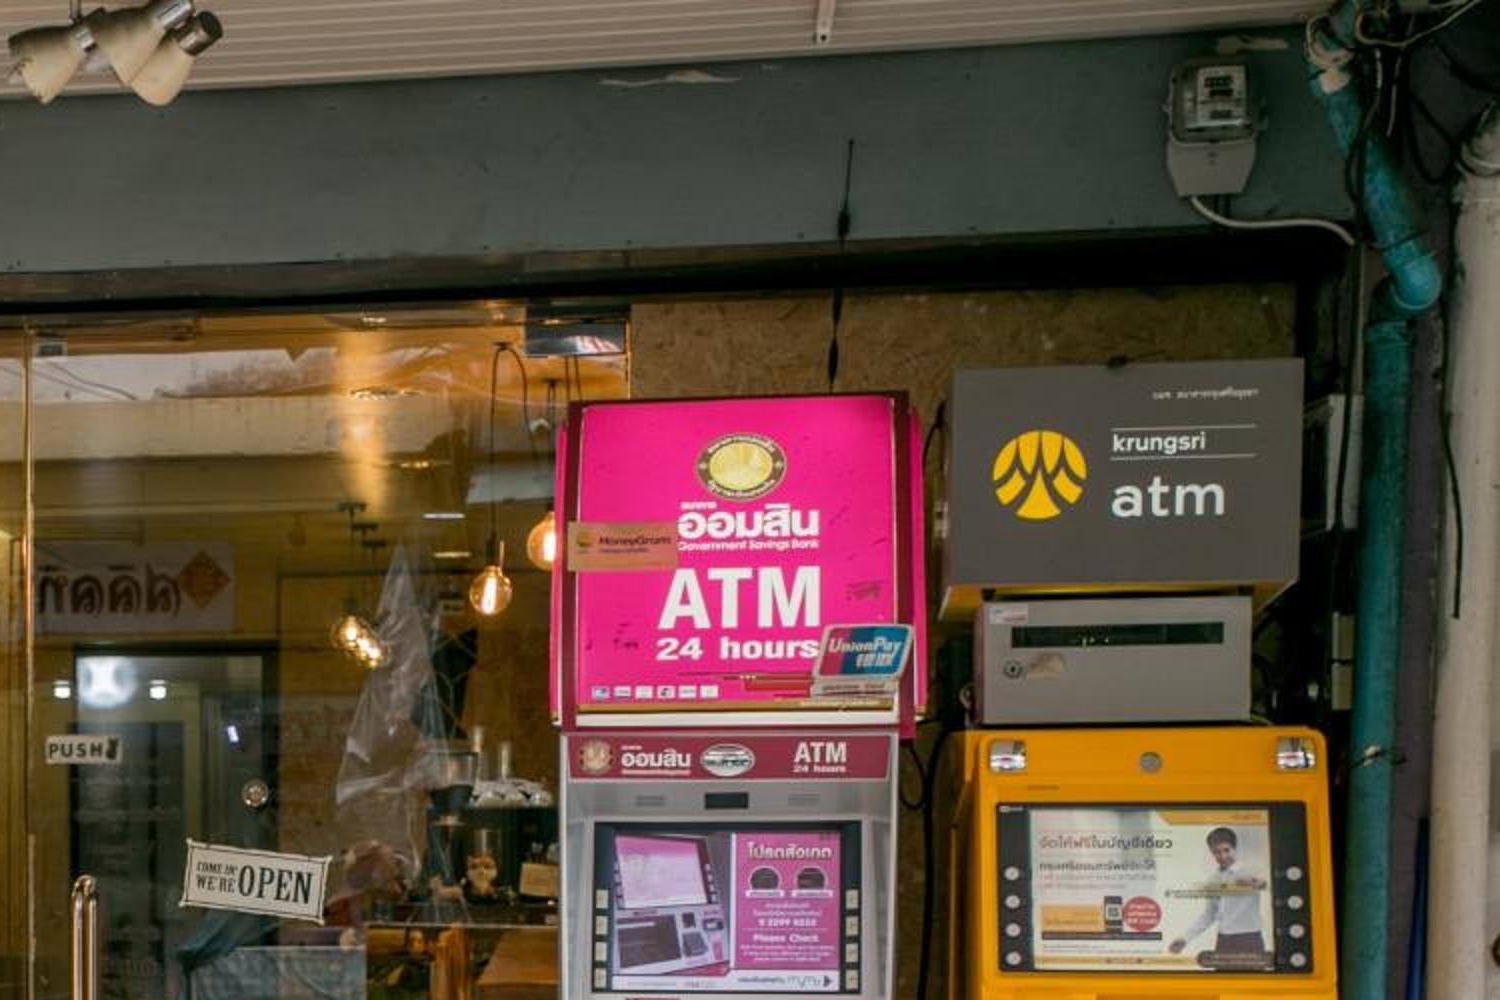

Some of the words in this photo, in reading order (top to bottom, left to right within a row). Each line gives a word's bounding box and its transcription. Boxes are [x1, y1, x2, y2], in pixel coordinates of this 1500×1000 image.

[1113, 431, 1206, 455] krungsri
[1111, 475, 1225, 517] atm
[677, 503, 820, 539] ออมสิน
[657, 565, 821, 630] ATM
[656, 636, 703, 661] 24
[720, 635, 820, 660] hours
[49, 742, 103, 760] PUSH
[621, 748, 691, 767] ออมสิน
[793, 742, 847, 763] ATM
[238, 865, 313, 904] OPEN
